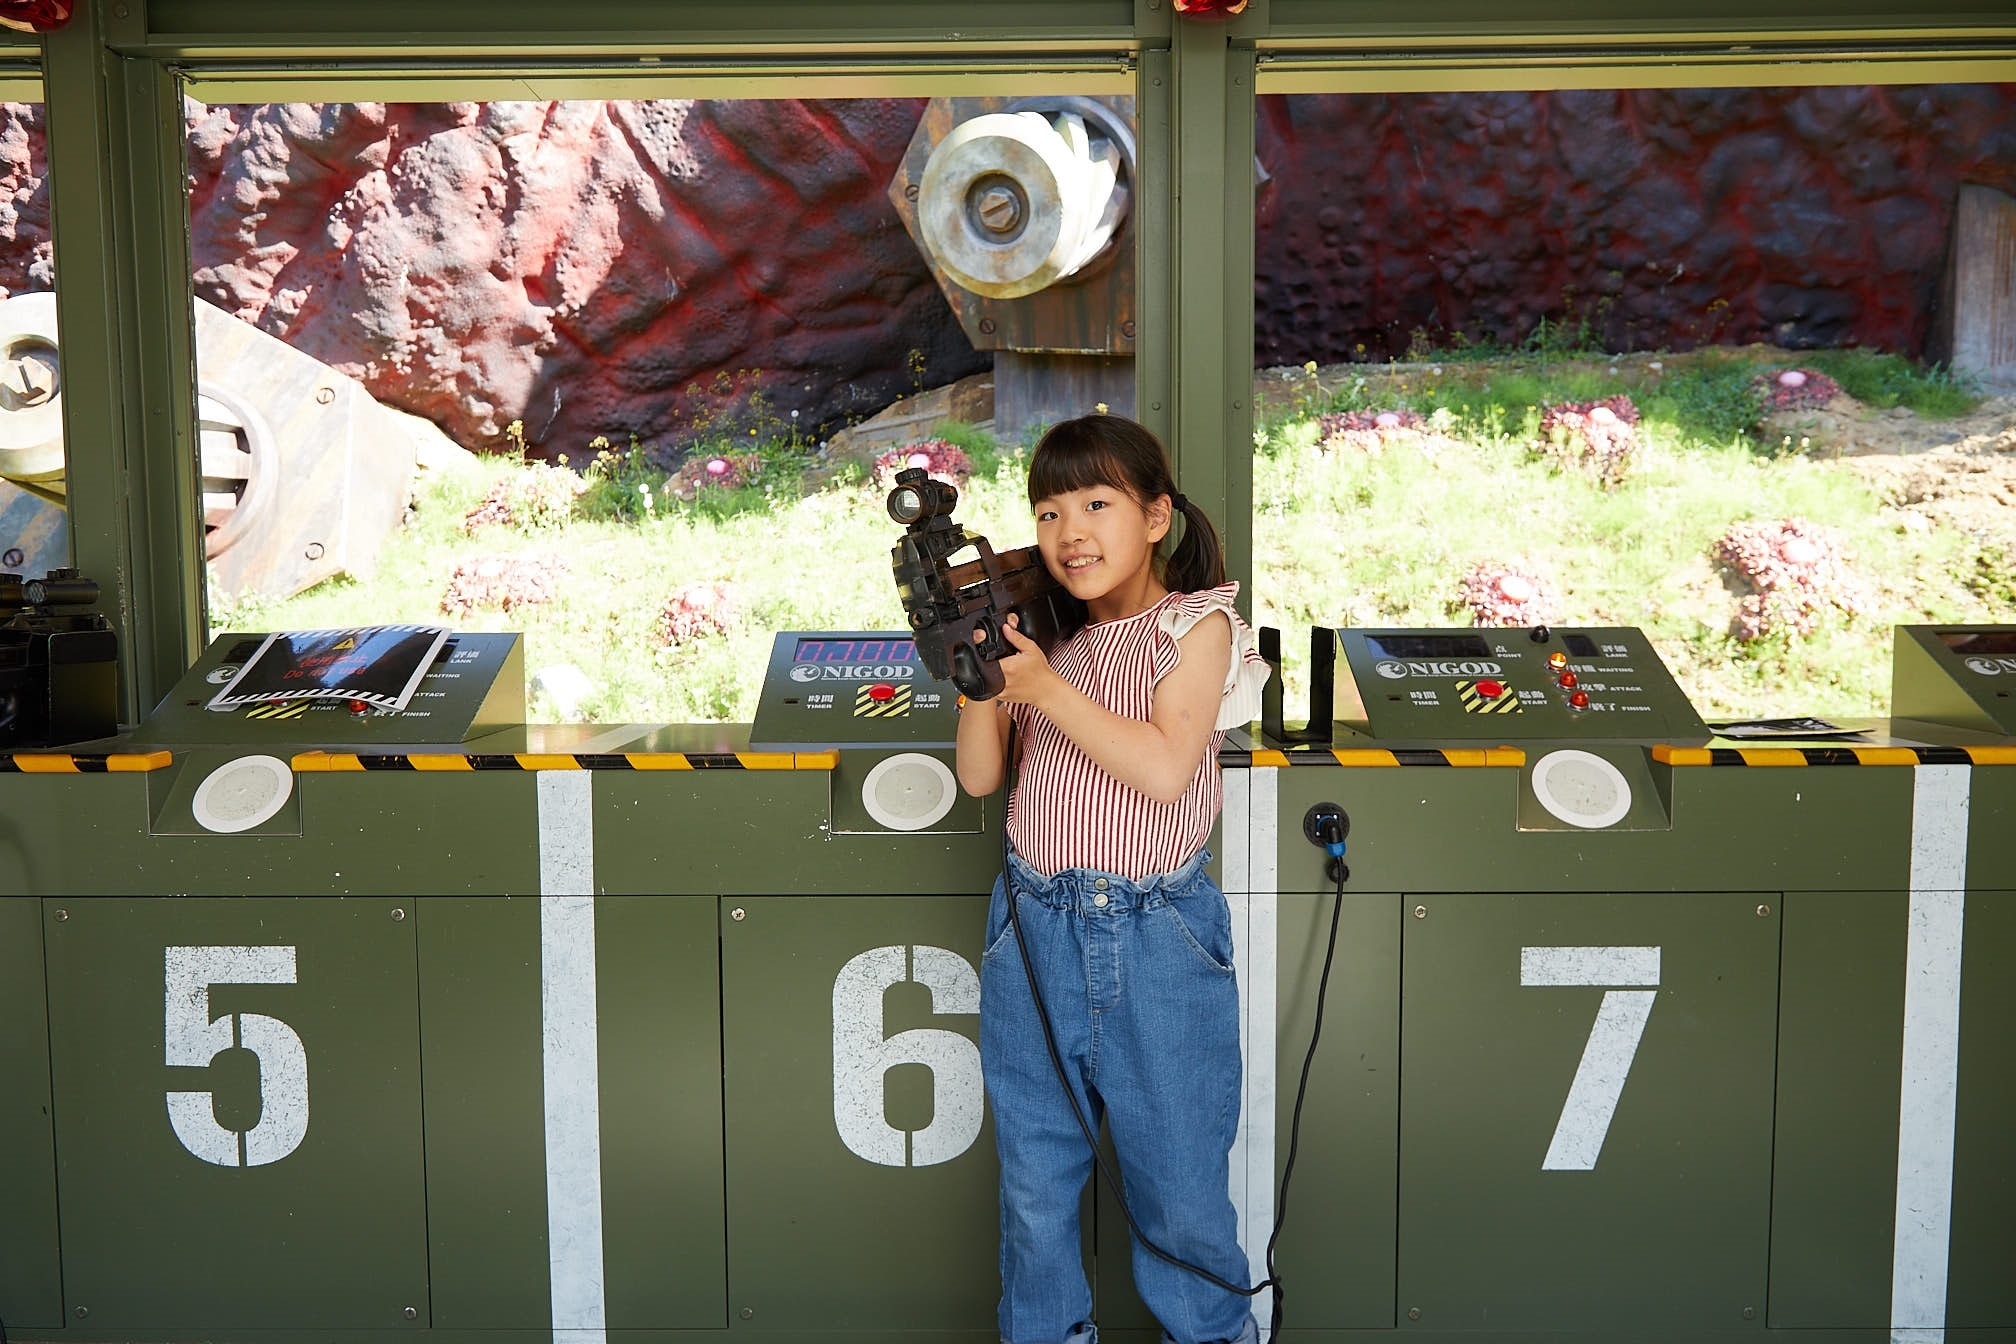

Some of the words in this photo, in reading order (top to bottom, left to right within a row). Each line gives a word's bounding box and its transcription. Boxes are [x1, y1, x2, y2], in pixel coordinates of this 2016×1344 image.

[824, 666, 914, 677] NIGOD
[1408, 662, 1502, 674] NIGOD
[165, 945, 309, 1167] 5
[832, 944, 984, 1168] 6
[1520, 946, 1661, 1171] 7
